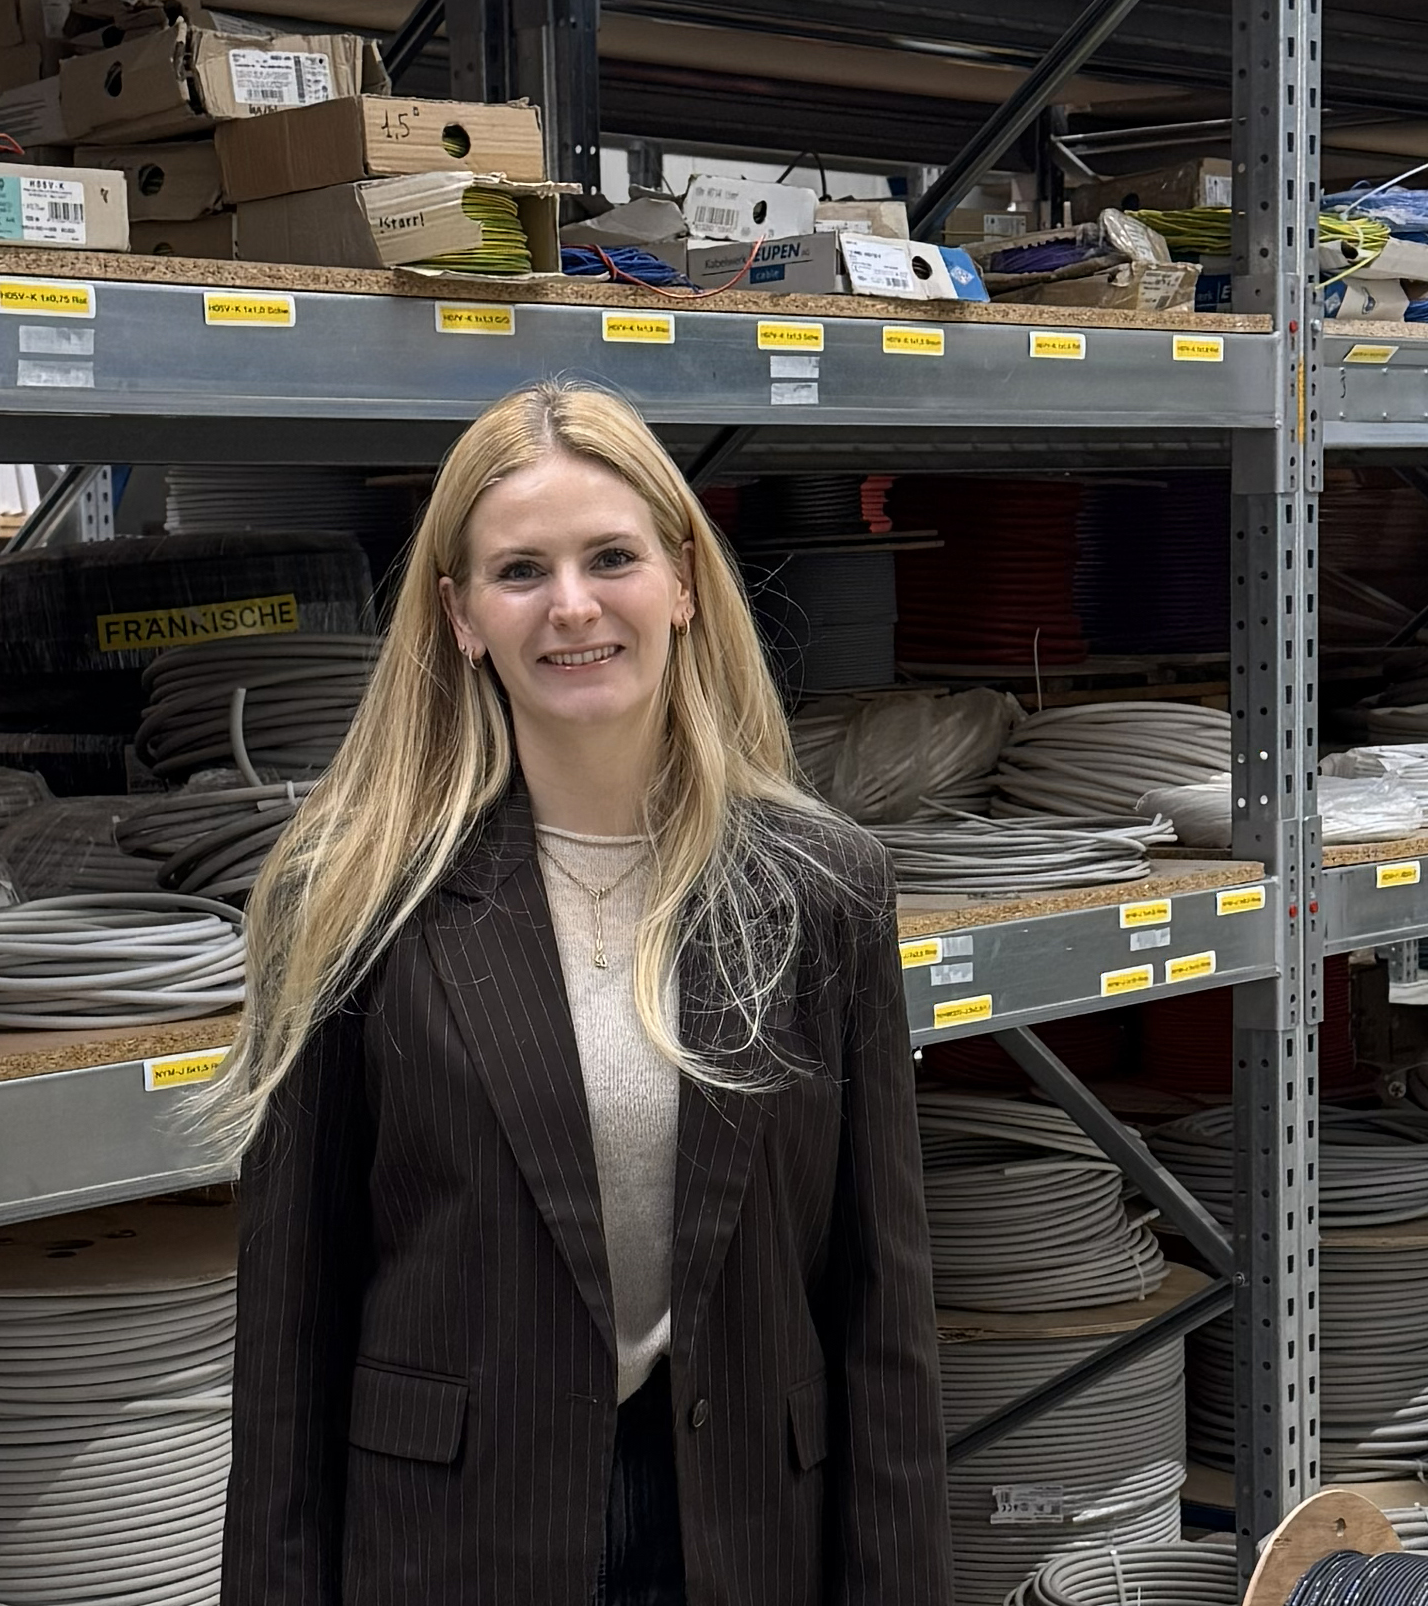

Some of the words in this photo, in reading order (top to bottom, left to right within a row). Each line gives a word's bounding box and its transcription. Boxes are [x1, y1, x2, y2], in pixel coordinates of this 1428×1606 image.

[752, 241, 802, 263] EUPEN
[0, 291, 38, 303] H05V-K
[40, 294, 70, 305] 1x0,75
[105, 601, 294, 646] FRÄNKISCHE
[155, 1065, 185, 1079] NYM-J
